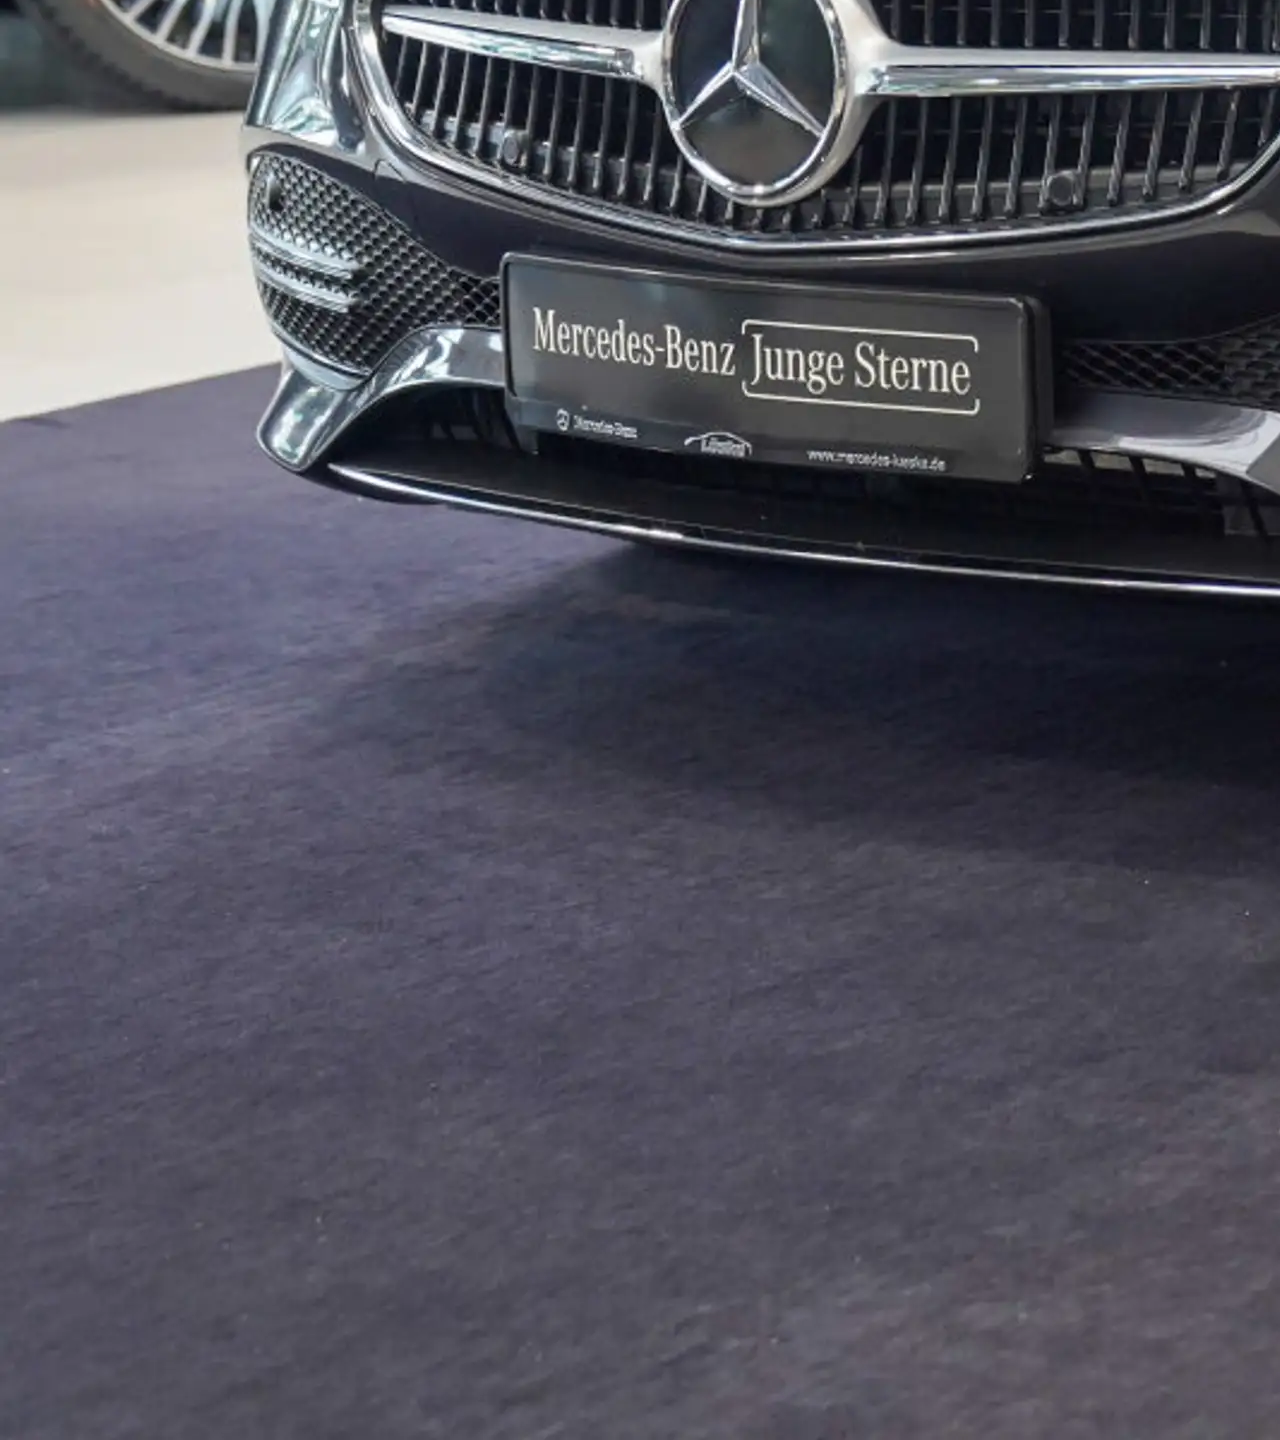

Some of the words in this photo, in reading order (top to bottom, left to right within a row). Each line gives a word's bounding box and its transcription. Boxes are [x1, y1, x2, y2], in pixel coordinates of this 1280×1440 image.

[533, 307, 735, 376] Mercedes-Benz
[751, 334, 844, 395] Junge
[855, 341, 971, 395] Sterne
